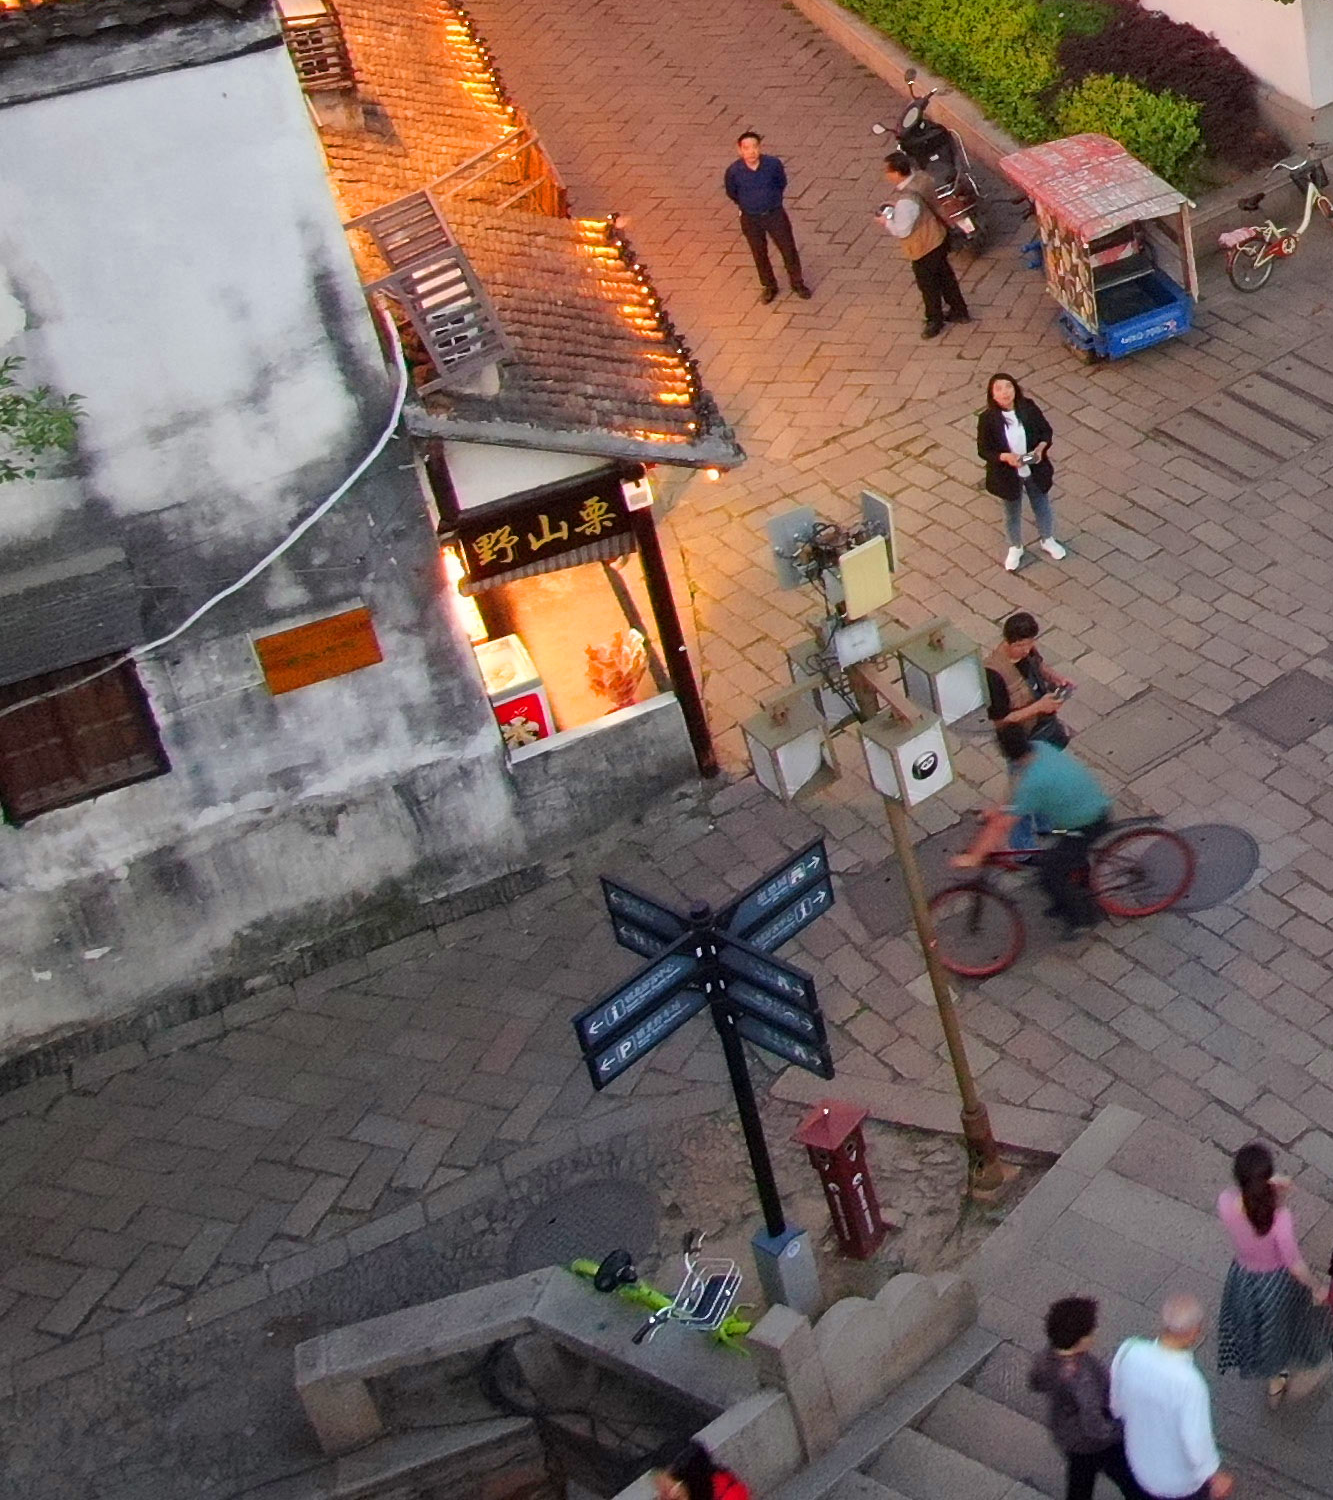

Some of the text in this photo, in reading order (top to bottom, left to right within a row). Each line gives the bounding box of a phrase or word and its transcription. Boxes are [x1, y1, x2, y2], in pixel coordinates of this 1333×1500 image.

[473, 496, 617, 566] 野山栗
[620, 1041, 632, 1059] P
